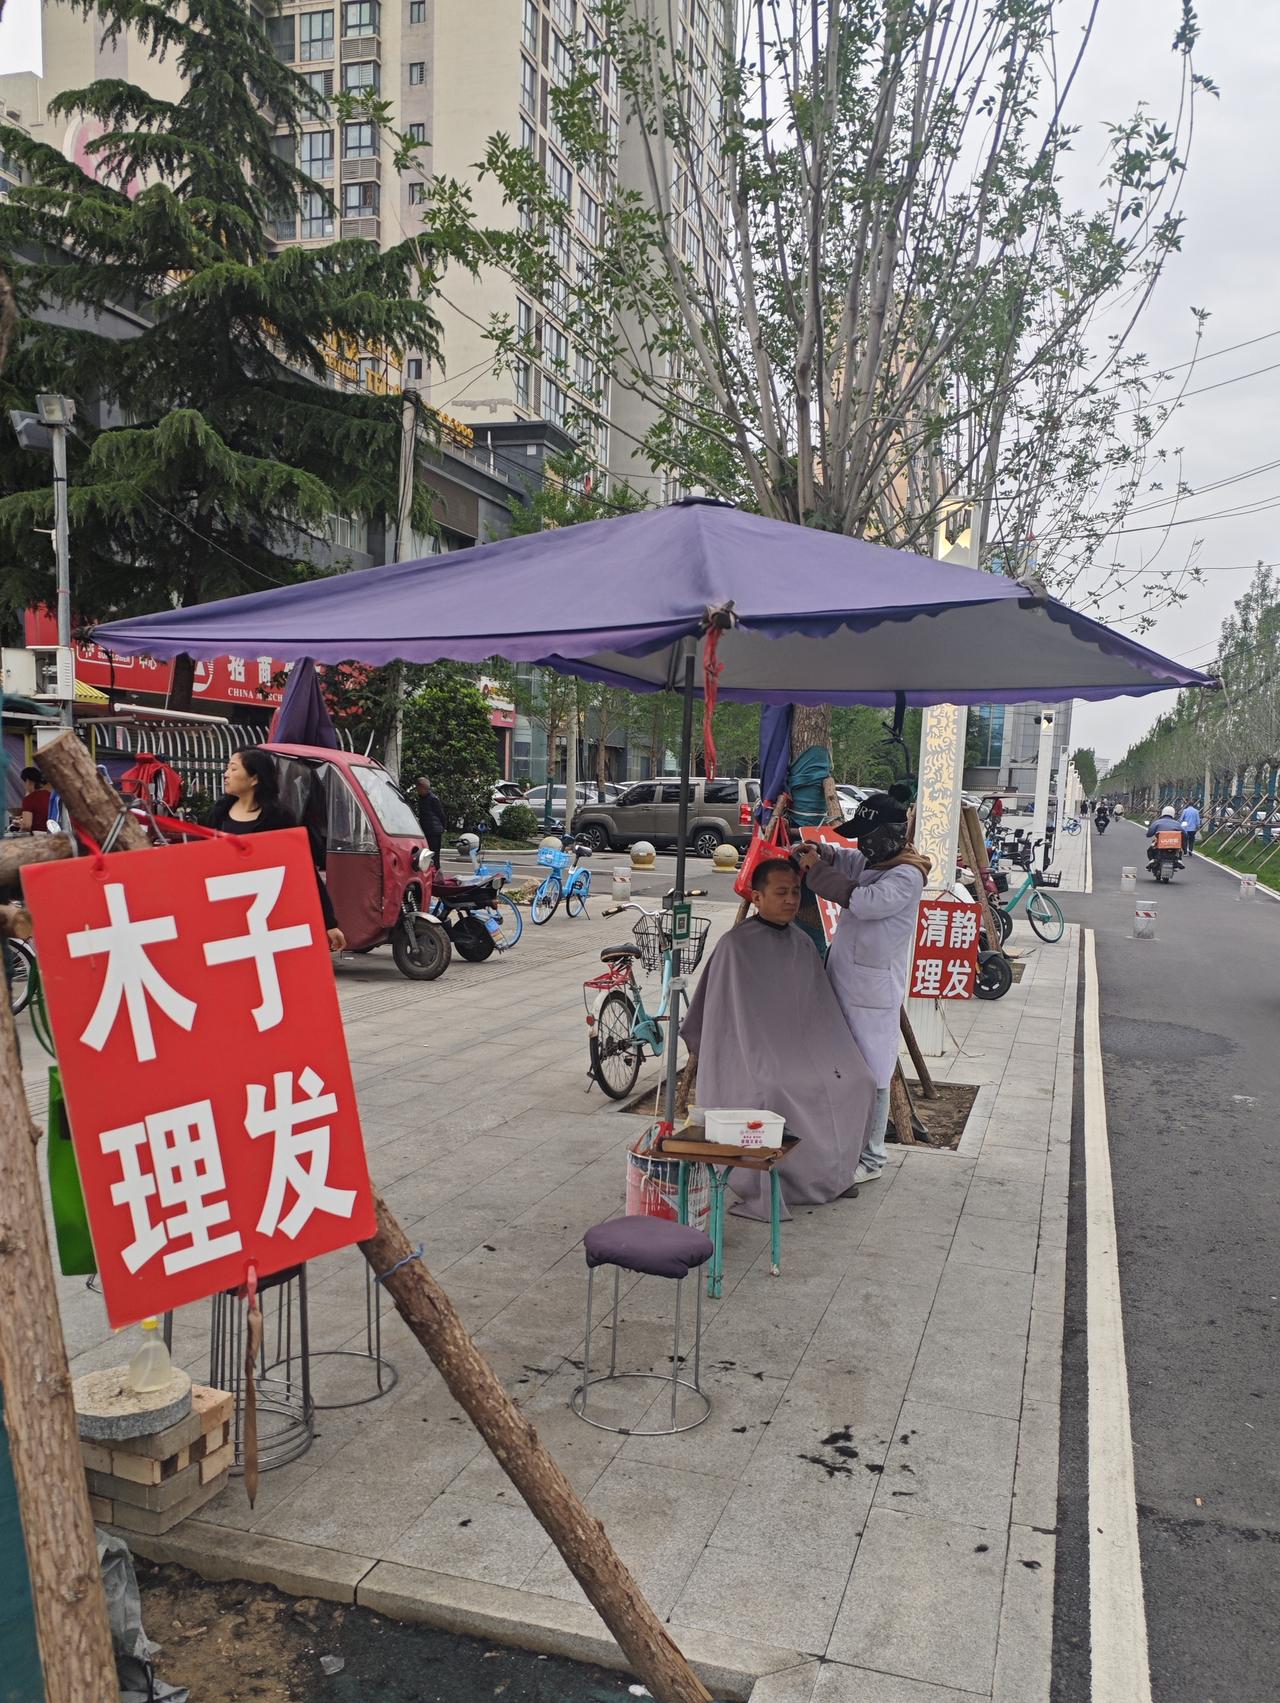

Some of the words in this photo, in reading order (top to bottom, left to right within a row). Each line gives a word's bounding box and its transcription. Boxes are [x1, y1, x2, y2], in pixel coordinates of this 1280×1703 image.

[227, 687, 254, 699] CHINA
[919, 907, 977, 949] 清静
[66, 865, 313, 1062] 木子
[912, 958, 971, 998] 理发
[98, 1066, 357, 1276] 理发
